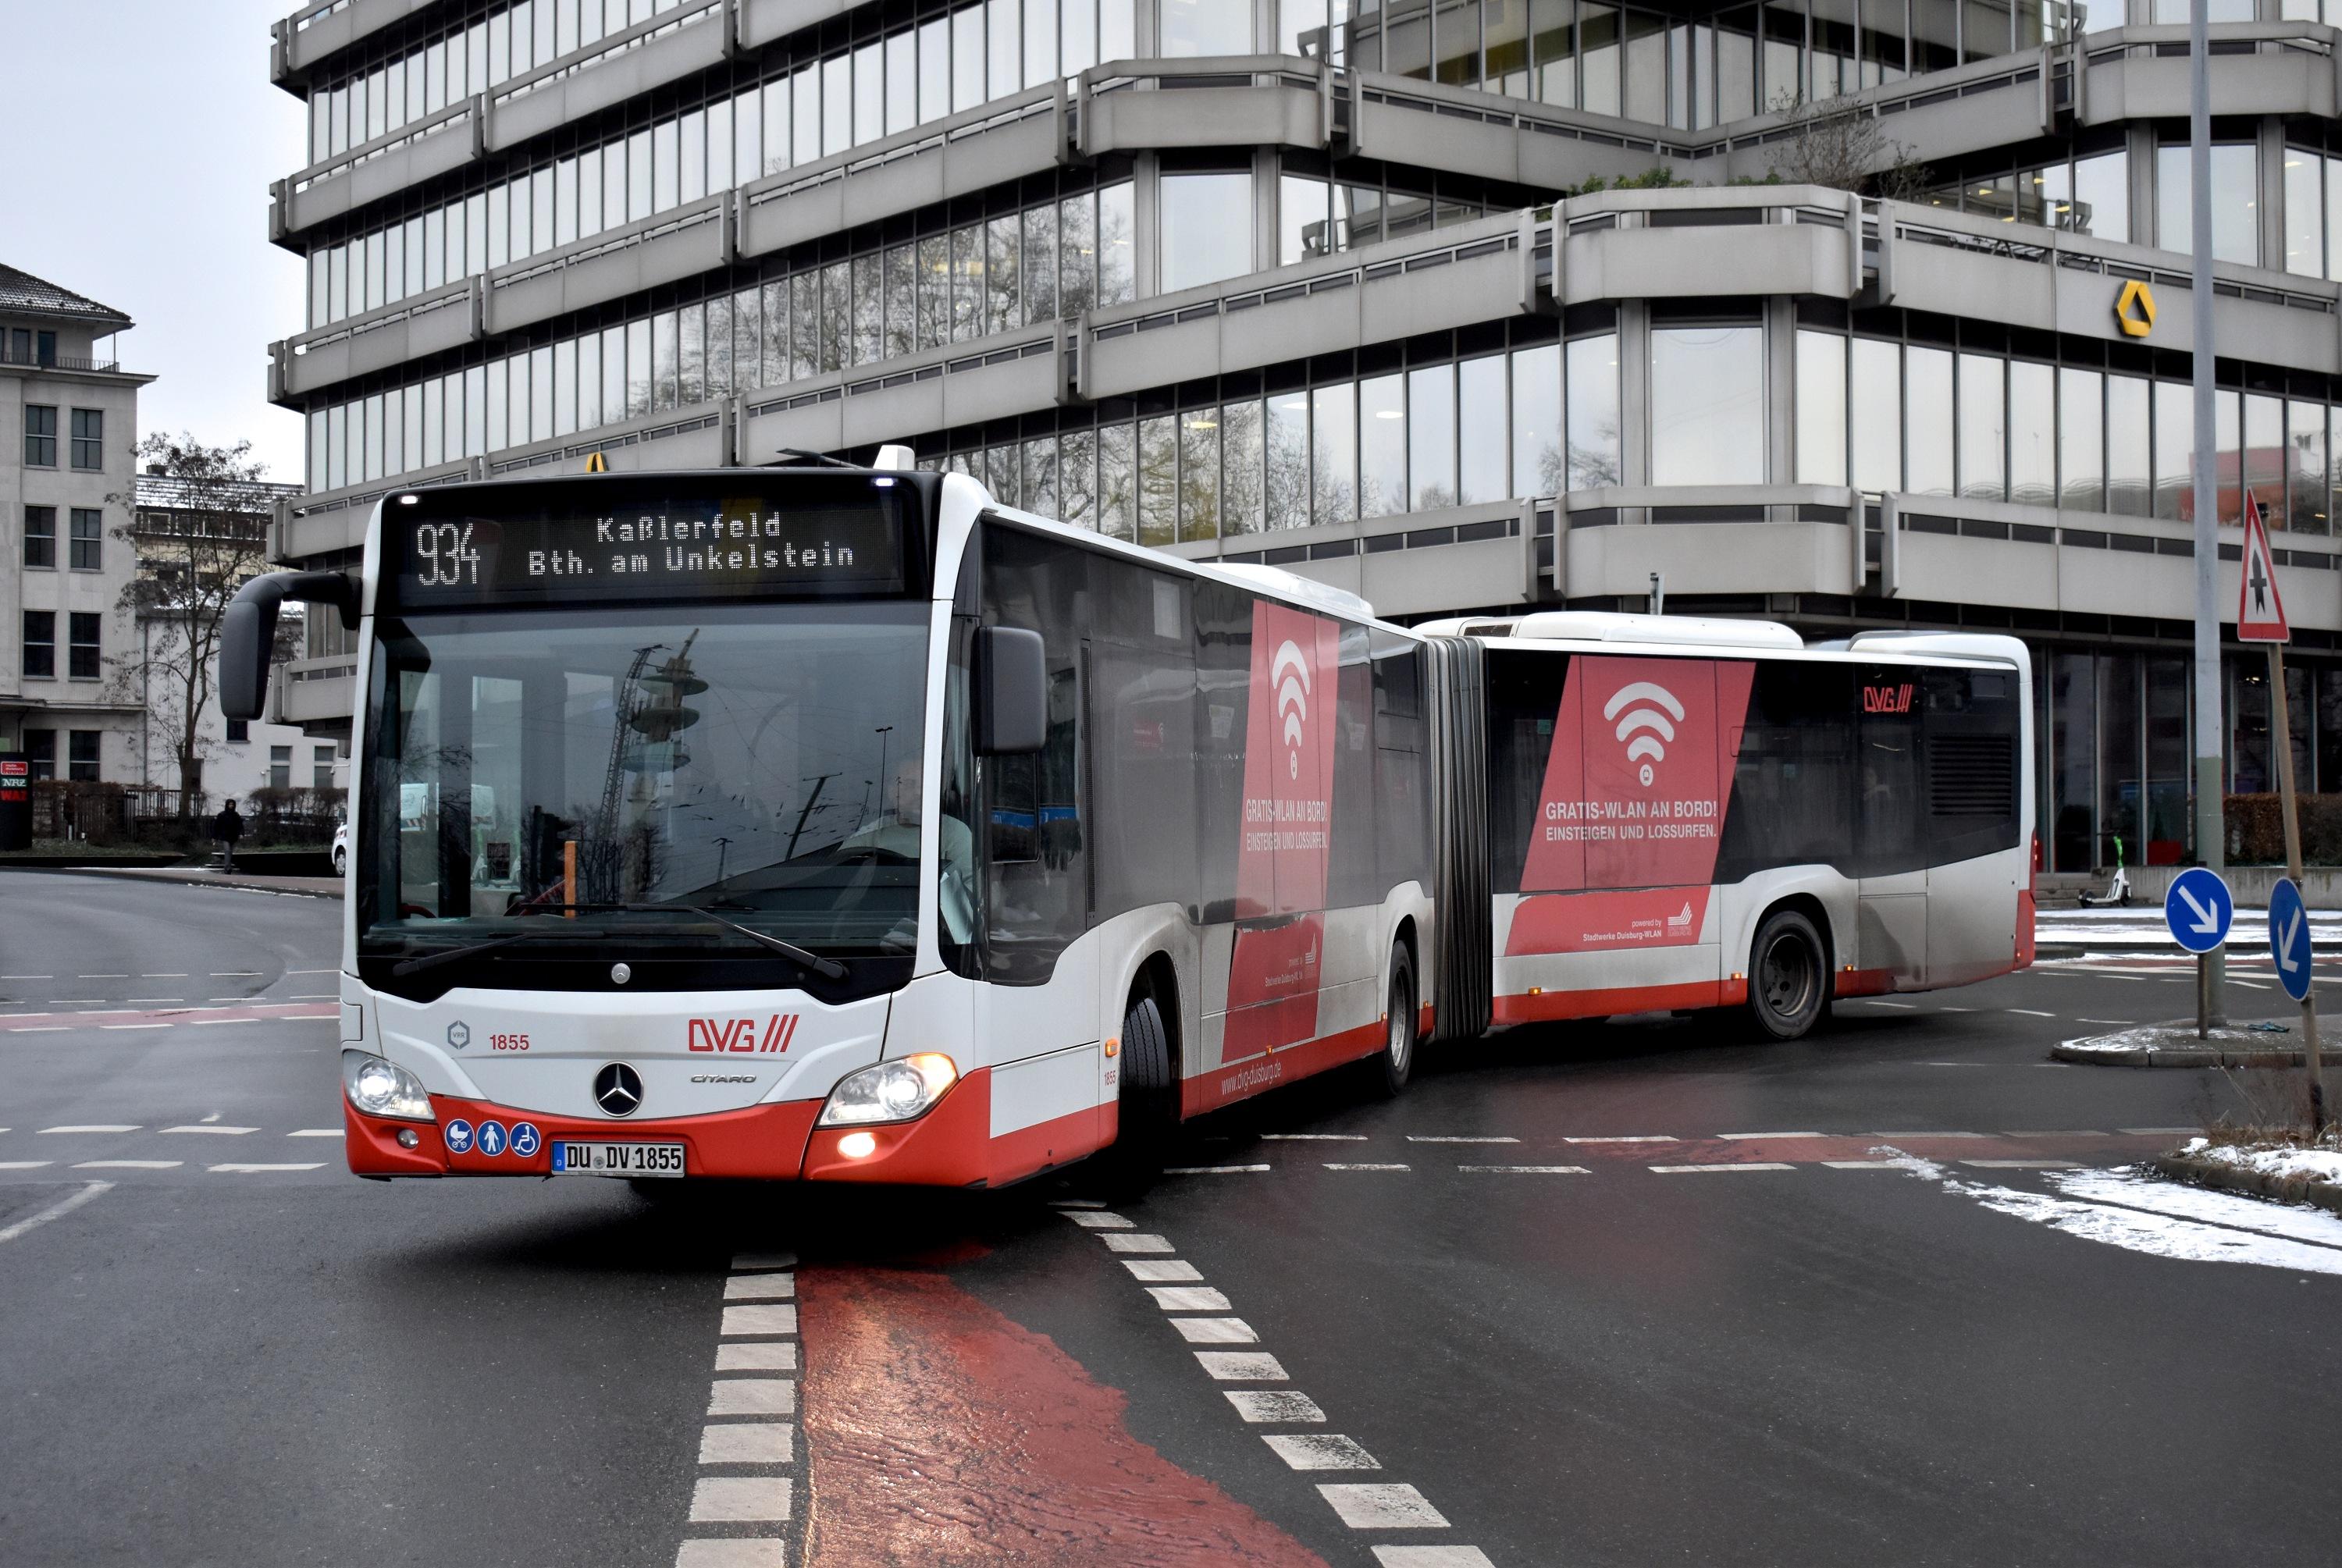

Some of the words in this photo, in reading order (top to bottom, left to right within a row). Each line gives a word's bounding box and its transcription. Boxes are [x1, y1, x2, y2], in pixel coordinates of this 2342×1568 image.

[598, 512, 780, 542] Kaßlerfeld
[418, 523, 480, 585] 934
[529, 550, 593, 575] Bth.
[612, 553, 647, 573] am
[666, 542, 852, 571] Unkelstein
[2, 778, 27, 787] NRZ
[1247, 798, 1294, 822] GRATIS-WLAN
[1296, 800, 1305, 822] AN
[1308, 800, 1326, 822] BORD!
[1546, 801, 1646, 820] GRATIS-WLAN
[1650, 801, 1669, 818] AN
[1675, 801, 1717, 817] BORD!
[1247, 831, 1280, 852] EINSTEIGEN
[1283, 831, 1294, 850] UND
[1296, 830, 1327, 850] LOSSURFEN.
[1546, 826, 1615, 841] EINSTEIGEN
[1620, 825, 1644, 840] UND
[1648, 824, 1717, 838] LOSSURFEN.
[1632, 919, 1653, 928] powered
[1655, 919, 1661, 928] by
[1583, 933, 1615, 941] Stadtwerke
[1617, 930, 1661, 940] Duisburg-WLAN
[489, 1034, 529, 1050] 1855
[690, 1074, 757, 1083] CITARO
[1105, 1070, 1116, 1086] 1855
[1222, 1058, 1281, 1096] www.dvg-duisburg.de
[567, 1146, 591, 1168] DU
[606, 1147, 630, 1168] DV
[635, 1147, 682, 1170] 1855
